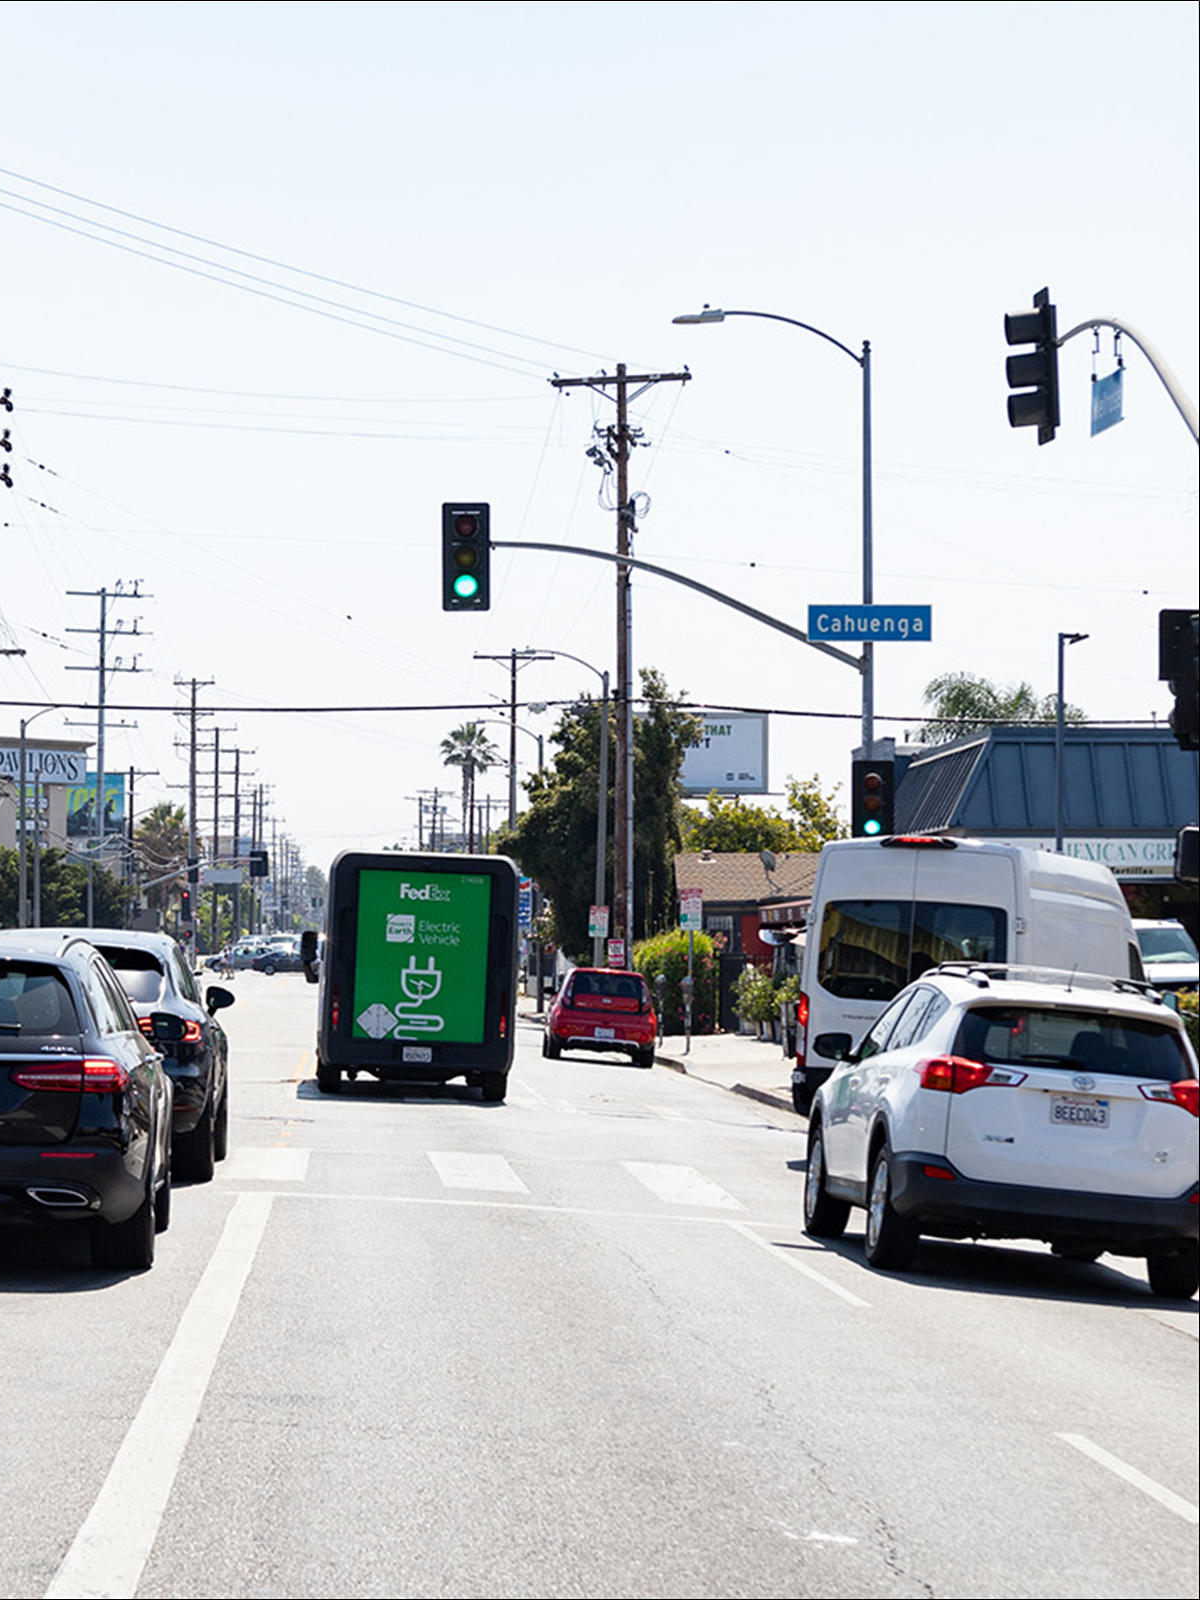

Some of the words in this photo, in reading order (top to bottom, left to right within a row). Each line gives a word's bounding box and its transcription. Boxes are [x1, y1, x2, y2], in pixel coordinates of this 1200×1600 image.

[817, 614, 923, 639] Cahuenga
[704, 725, 732, 736] THAT
[1143, 843, 1173, 861] GRI
[400, 883, 451, 901] FedEx
[419, 920, 461, 934] Electric
[419, 934, 461, 947] Vehicle
[1054, 1105, 1107, 1124] 8EEC043
